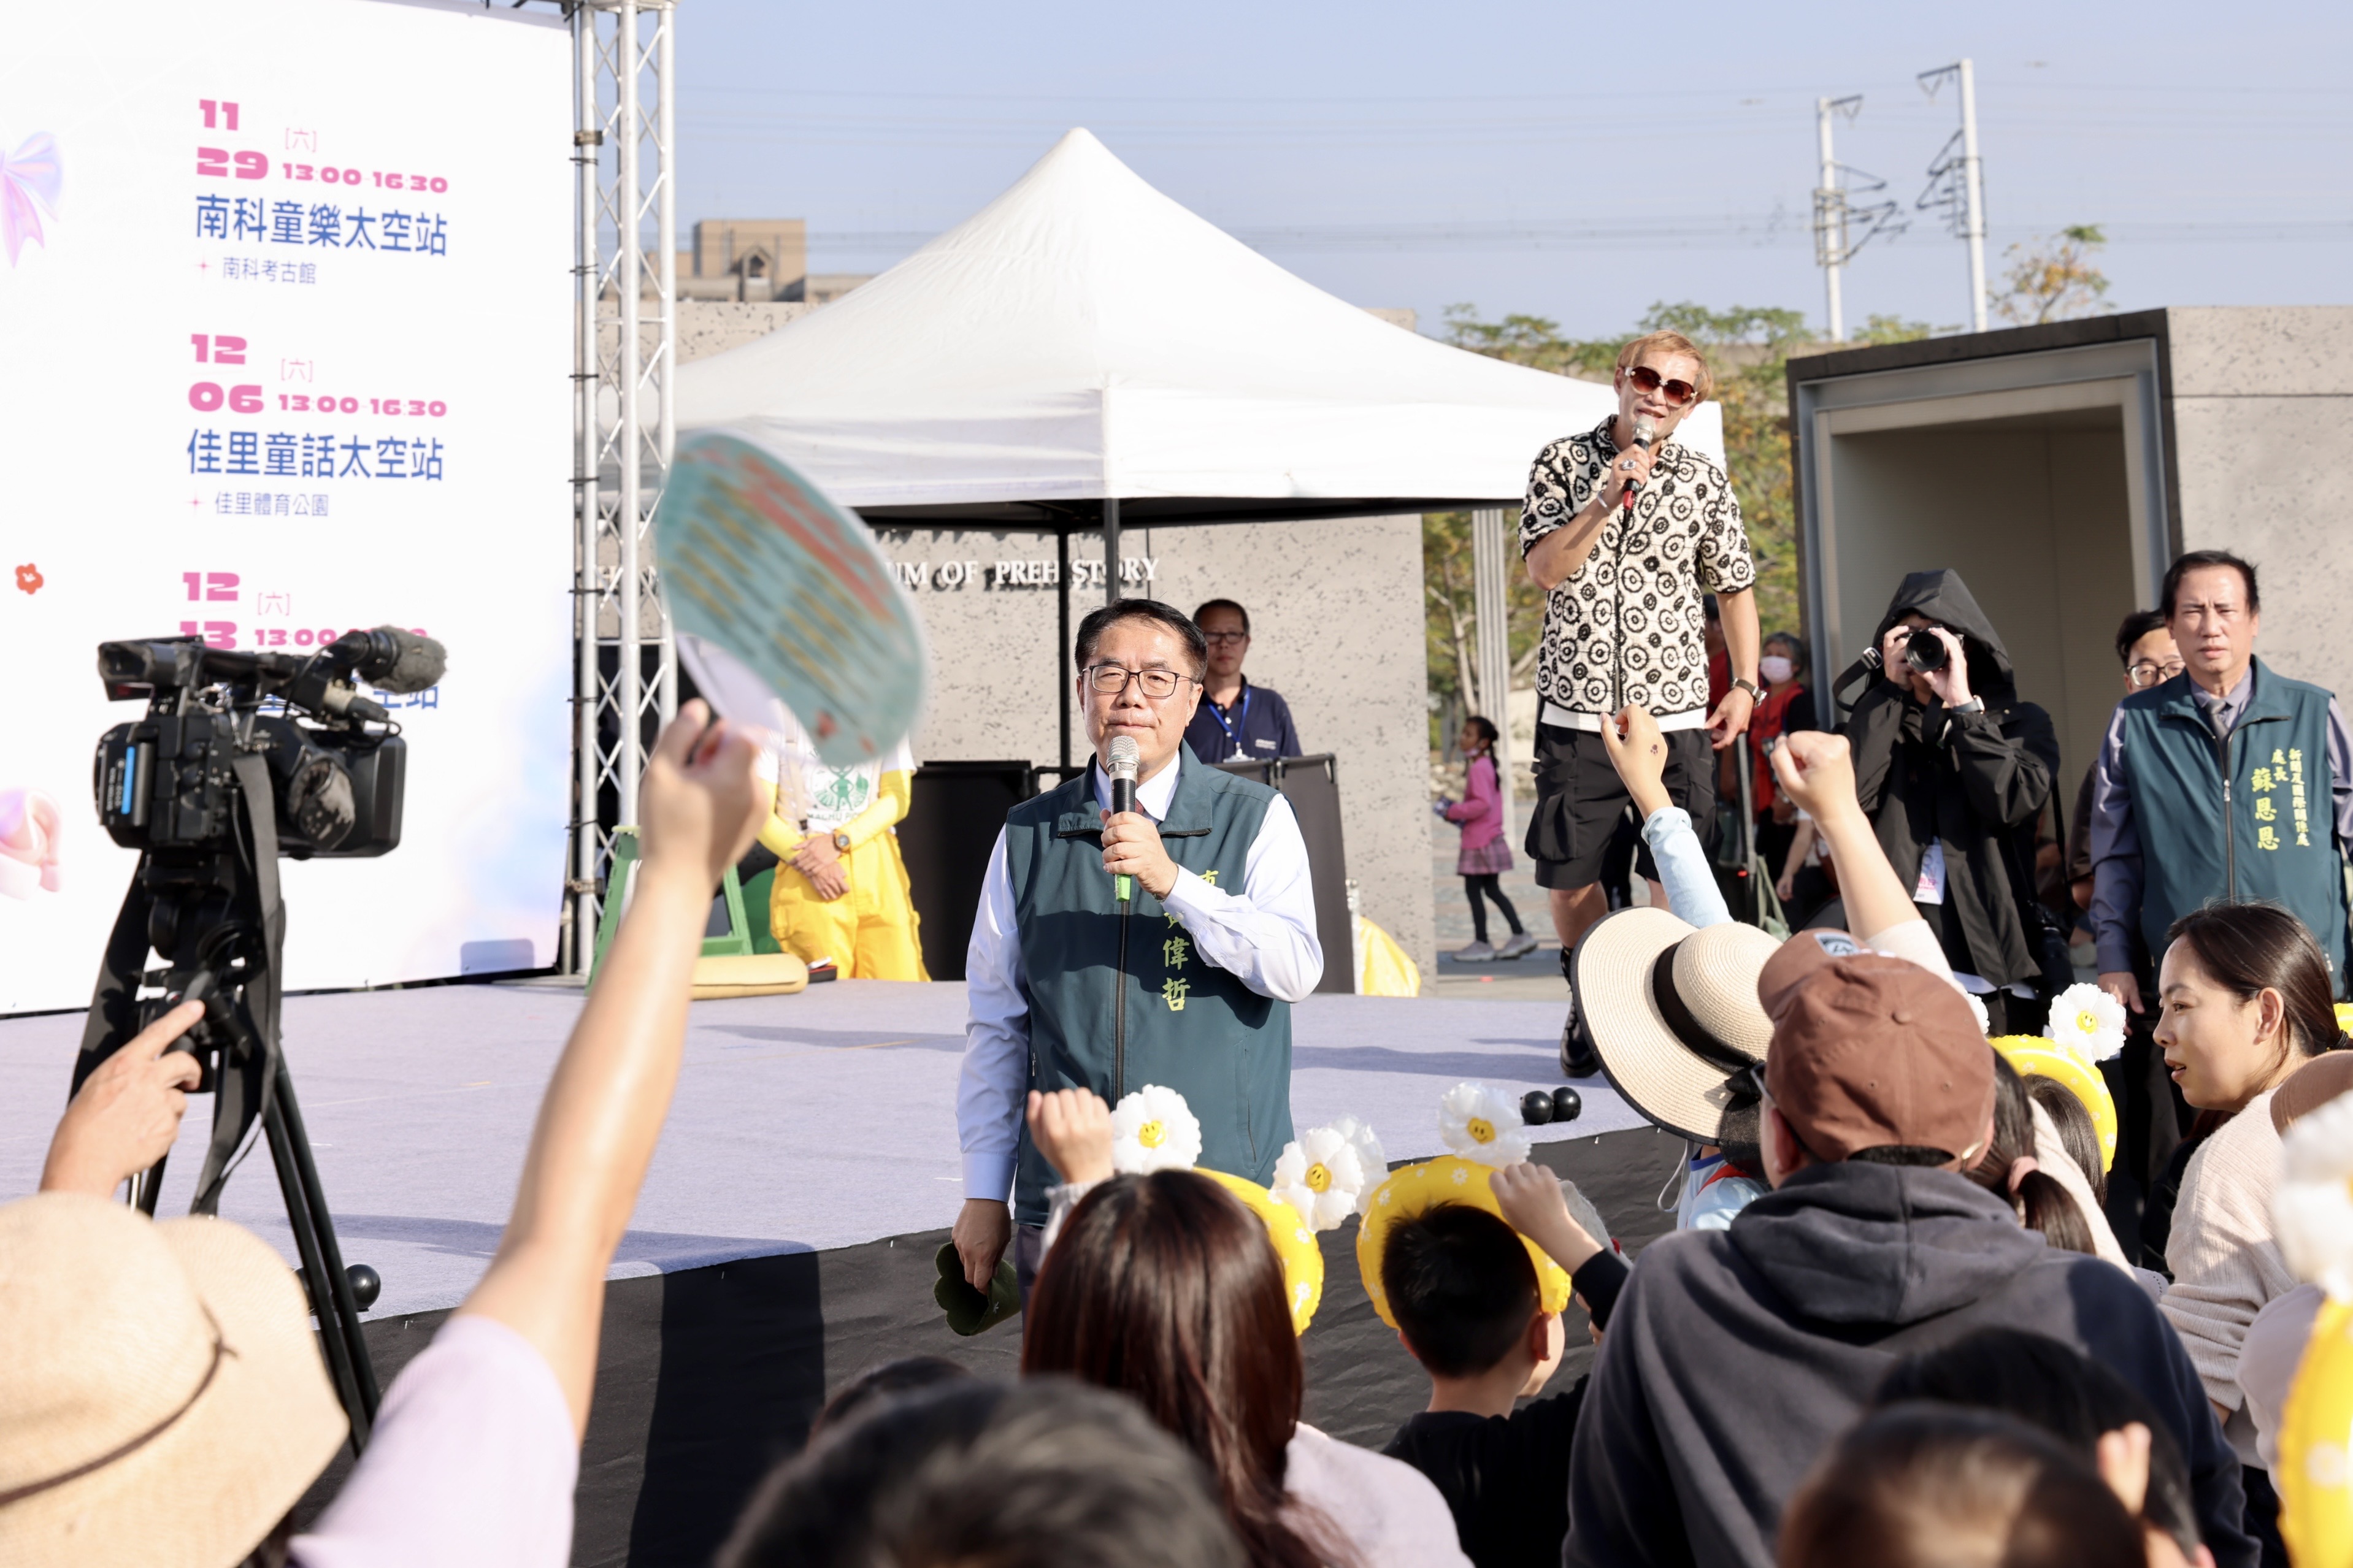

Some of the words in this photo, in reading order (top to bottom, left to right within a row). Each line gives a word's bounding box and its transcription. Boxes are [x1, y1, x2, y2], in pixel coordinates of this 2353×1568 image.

[199, 99, 239, 131] 11
[196, 147, 269, 180] 29
[196, 193, 447, 256] 南科童樂太空站
[223, 256, 317, 285] 南科考古館
[191, 334, 247, 365] 12
[188, 381, 264, 414] 06
[187, 429, 444, 481] 佳里童話太空站
[215, 491, 329, 516] 佳里體育公園
[941, 560, 978, 584] OF
[994, 557, 1159, 584] PREHSTRY
[182, 572, 240, 602] 12
[1162, 912, 1191, 1012] 偉哲
